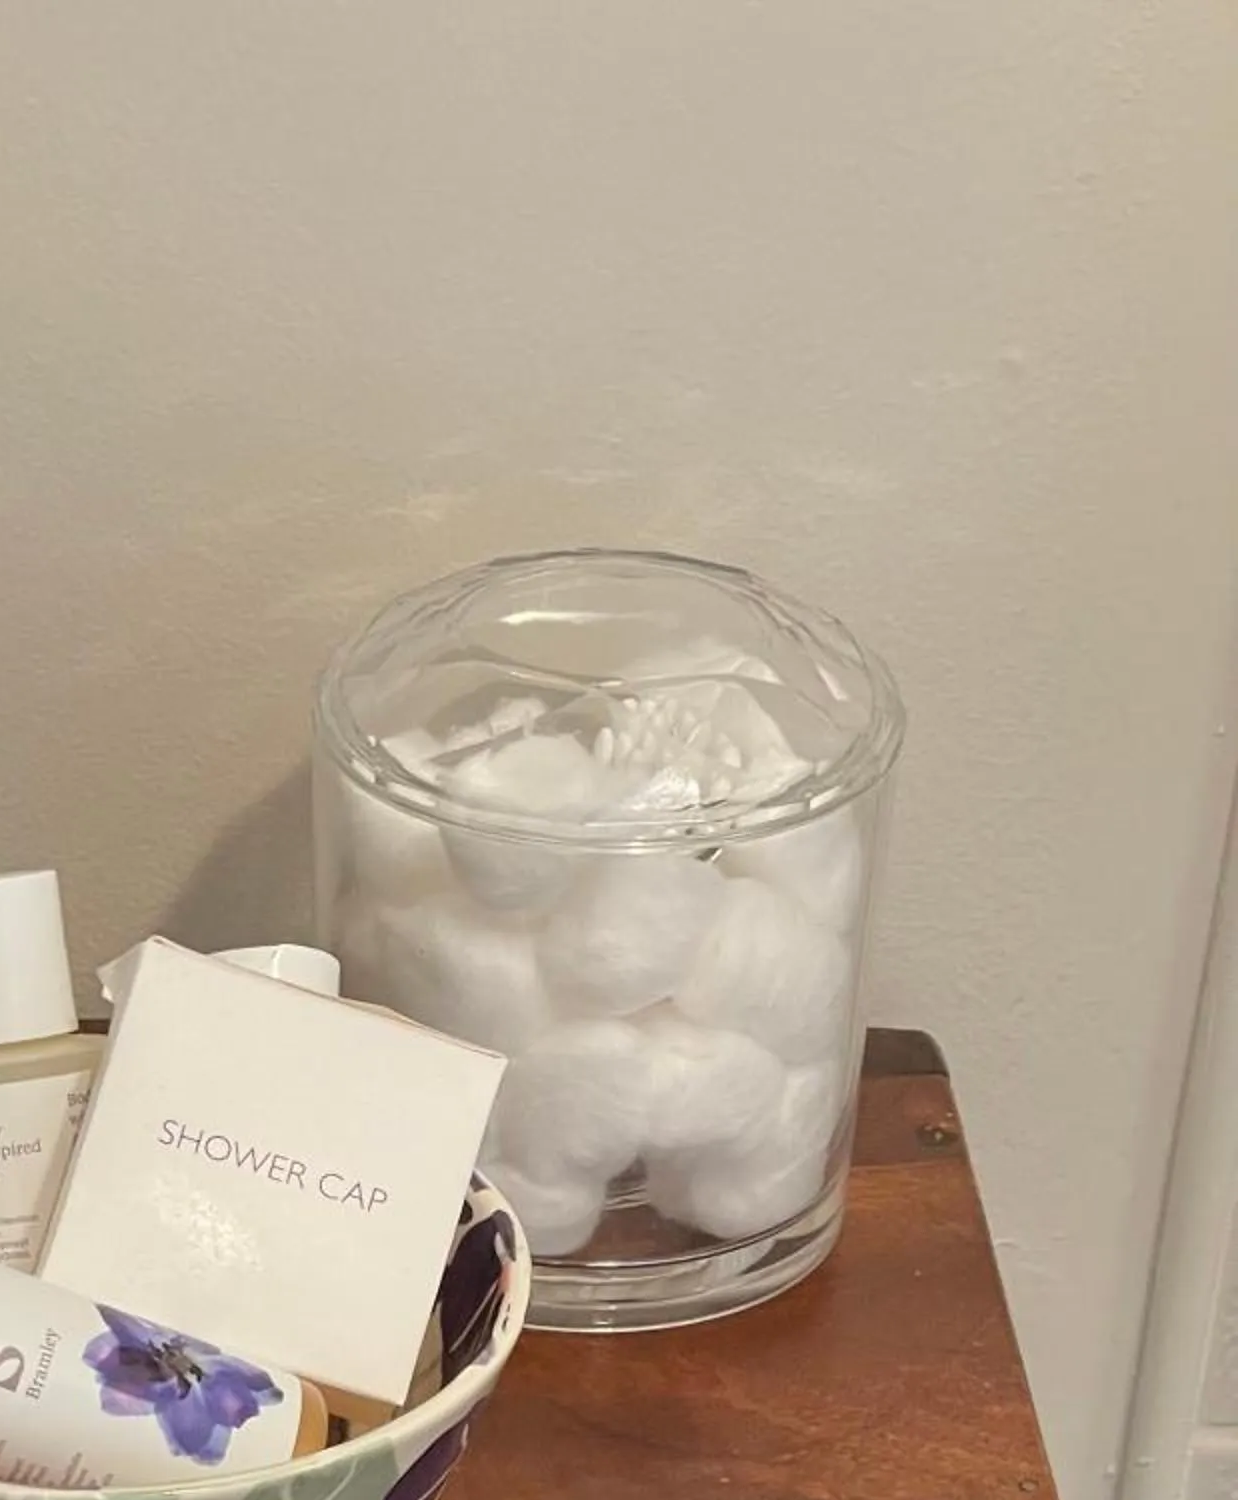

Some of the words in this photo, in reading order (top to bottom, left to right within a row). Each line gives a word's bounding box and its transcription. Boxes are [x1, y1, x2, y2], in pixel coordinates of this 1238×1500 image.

[157, 1119, 308, 1190] SHOWER
[319, 1172, 388, 1213] CAP
[25, 1326, 63, 1400] Bramley
